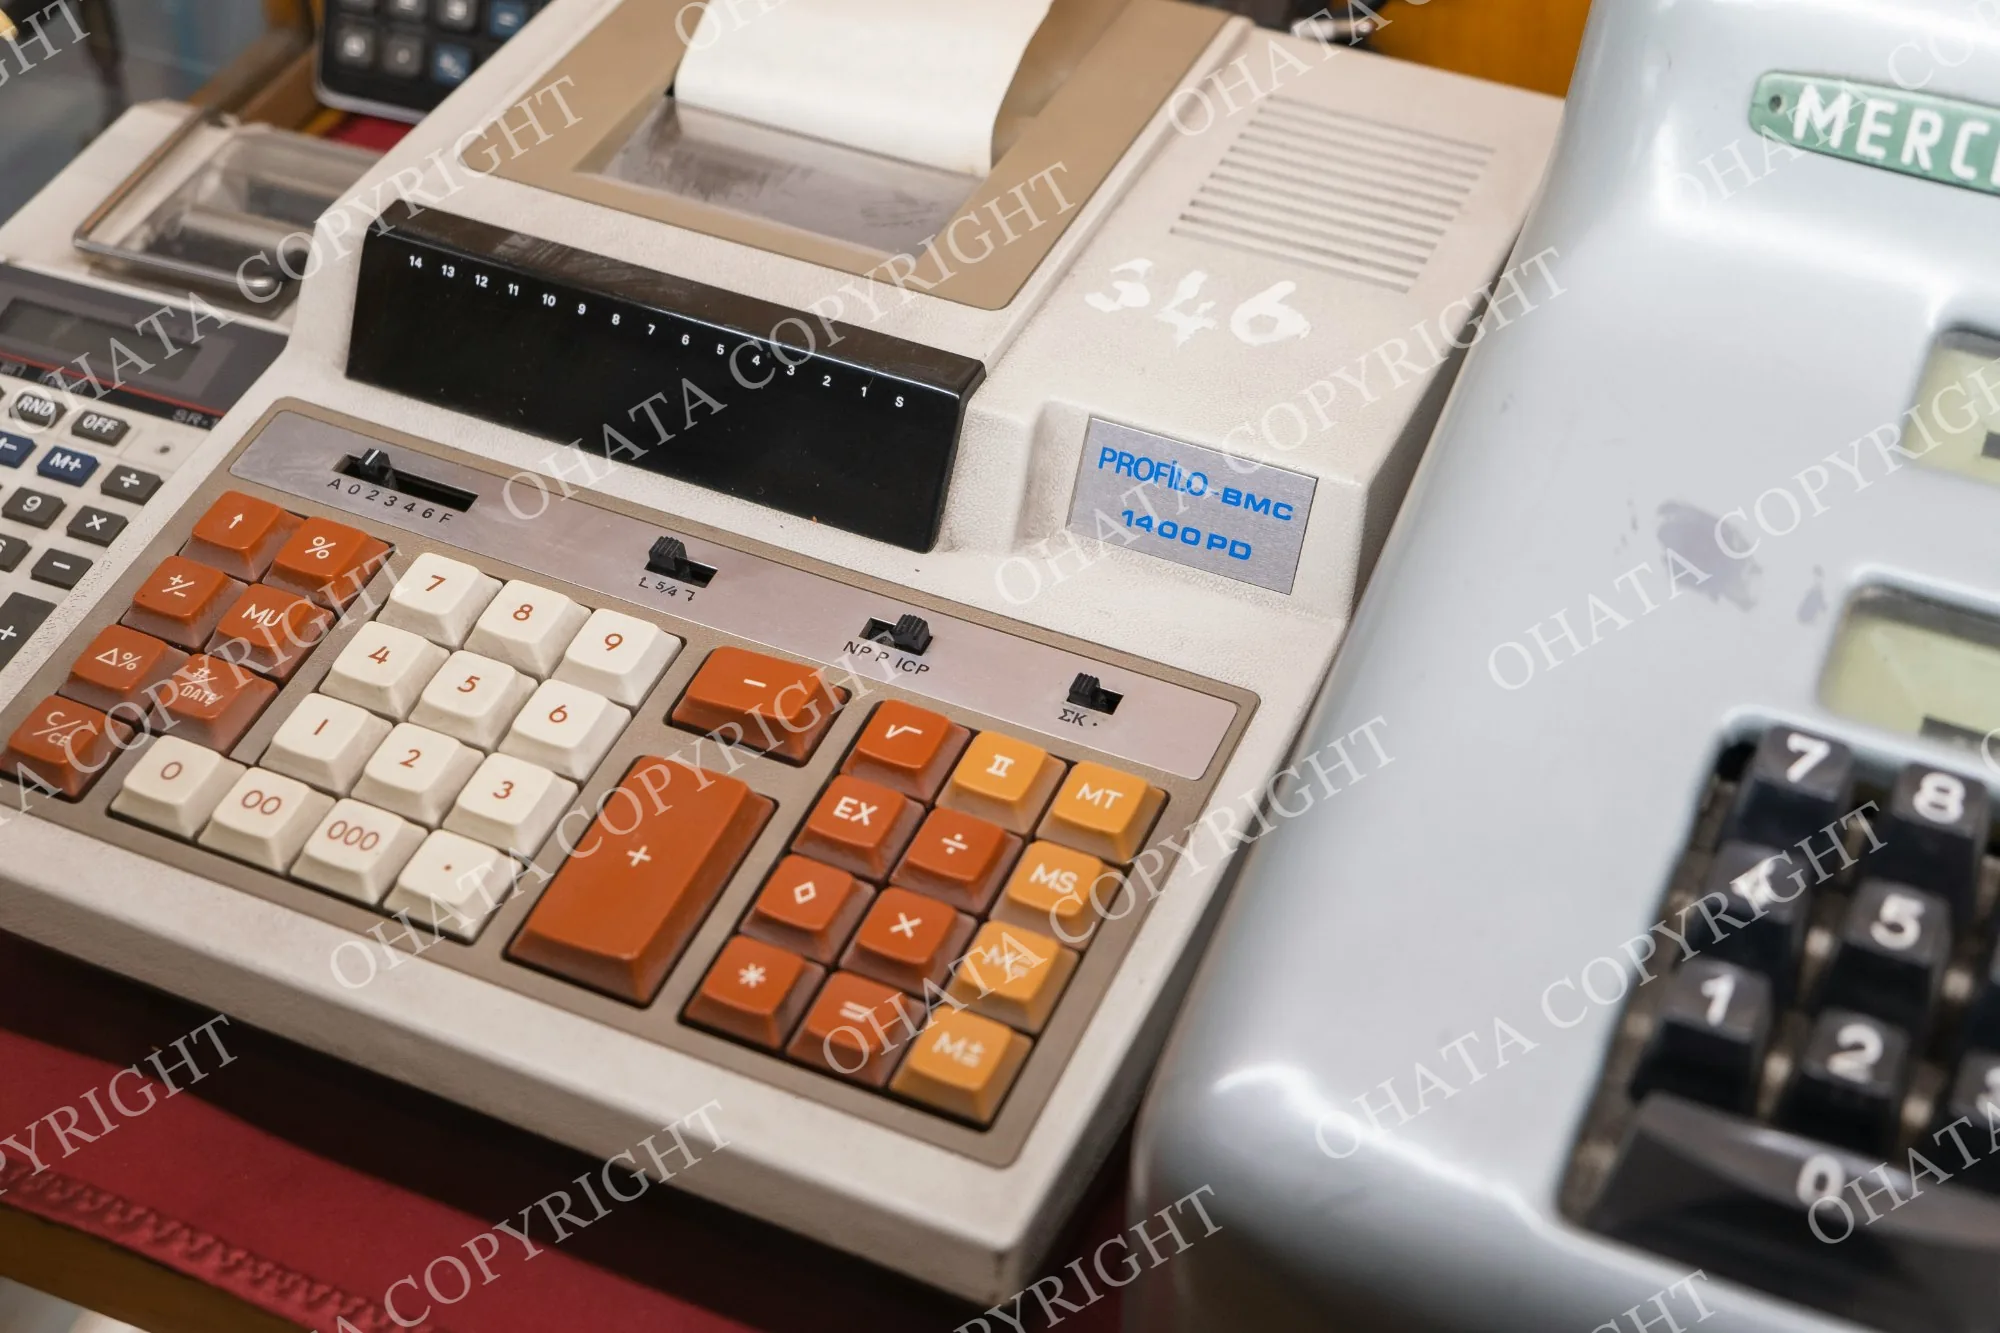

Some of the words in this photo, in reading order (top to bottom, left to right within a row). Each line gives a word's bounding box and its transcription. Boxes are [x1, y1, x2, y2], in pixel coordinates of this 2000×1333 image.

[1793, 84, 2000, 187] MERC
[1085, 258, 1311, 346] 346
[409, 256, 422, 268] 14
[442, 264, 455, 277] 13
[475, 275, 488, 288] 12
[508, 283, 519, 296] 11
[542, 293, 556, 307] 10
[578, 303, 586, 315] 9
[611, 313, 620, 325] 8
[648, 324, 655, 335] 7
[681, 334, 690, 345] 6
[716, 344, 725, 355] 5
[752, 355, 761, 366] 4
[787, 364, 796, 376] 3
[822, 375, 832, 387] 2
[861, 386, 867, 397] 1
[17, 396, 55, 417] RND
[82, 413, 120, 434] OFF
[50, 452, 82, 473] M+
[23, 496, 41, 512] 9
[1121, 510, 1200, 547] 1400
[1206, 533, 1252, 561] PD
[425, 575, 446, 594] 7
[656, 581, 678, 597] 5/4
[241, 603, 284, 628] MU
[513, 604, 533, 622] 8
[604, 633, 624, 651] 9
[368, 645, 390, 664] 4
[180, 684, 219, 706] DATE
[457, 675, 481, 694] 5
[549, 704, 567, 723] 6
[313, 719, 330, 736] 1
[400, 749, 421, 768] 2
[1787, 732, 1830, 784] 7
[493, 781, 514, 800] 3
[1076, 782, 1123, 810] MT
[1913, 771, 1965, 824] 8
[833, 796, 878, 826] EX
[1030, 864, 1078, 896] MS
[1871, 893, 1925, 949] 5
[1701, 974, 1735, 1026] 1
[1827, 1023, 1883, 1084] 2
[1796, 1153, 1844, 1210] 0
